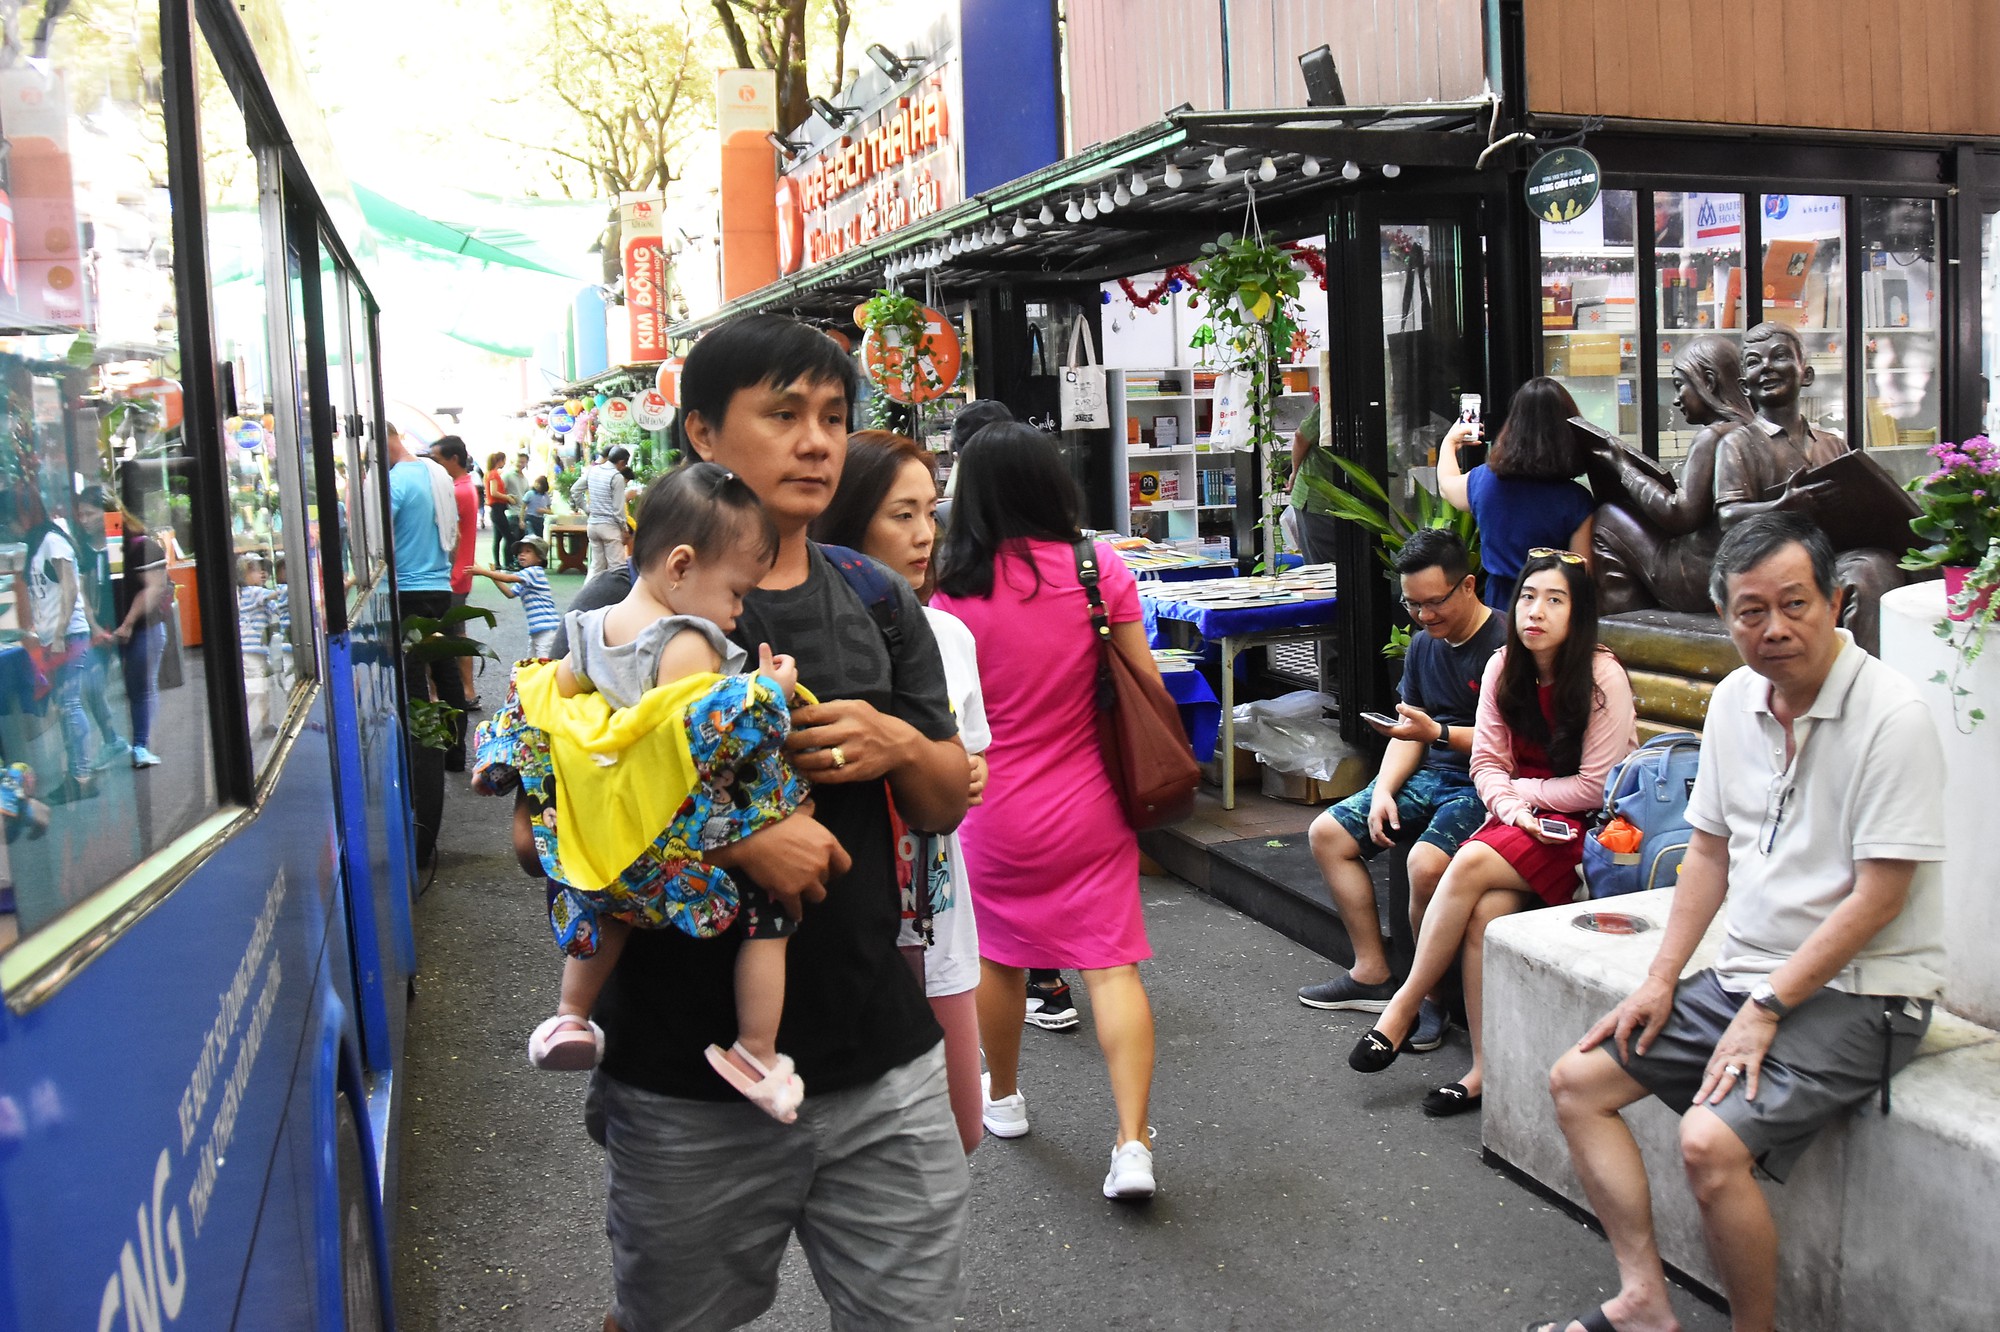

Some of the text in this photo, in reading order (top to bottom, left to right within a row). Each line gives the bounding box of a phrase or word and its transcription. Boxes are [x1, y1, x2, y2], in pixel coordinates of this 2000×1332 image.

[825, 136, 873, 199] SÁCH
[868, 97, 912, 171] THÁI
[629, 246, 655, 350] KIM ĐỒNG
[657, 333, 665, 348] KIM
[1143, 476, 1154, 488] PR
[177, 1084, 195, 1157] XE
